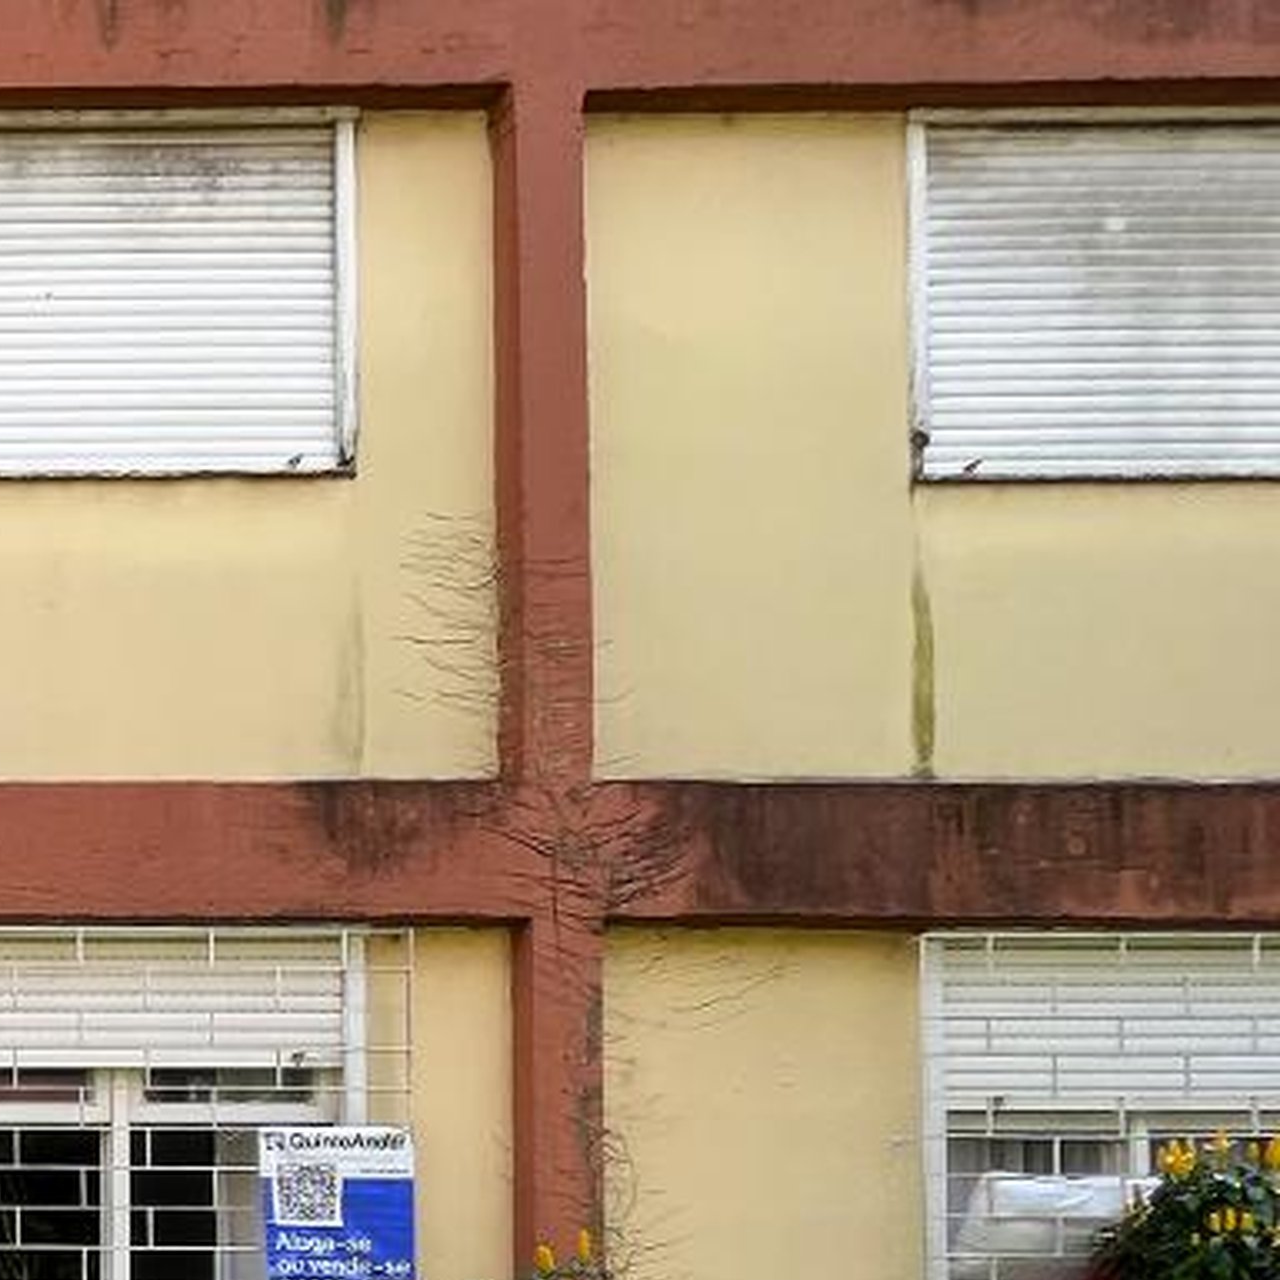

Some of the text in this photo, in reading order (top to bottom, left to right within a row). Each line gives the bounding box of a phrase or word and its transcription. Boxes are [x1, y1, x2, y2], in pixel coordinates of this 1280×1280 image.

[275, 1231, 371, 1256] Aluga-se
[277, 1256, 411, 1276] ou vende-se
